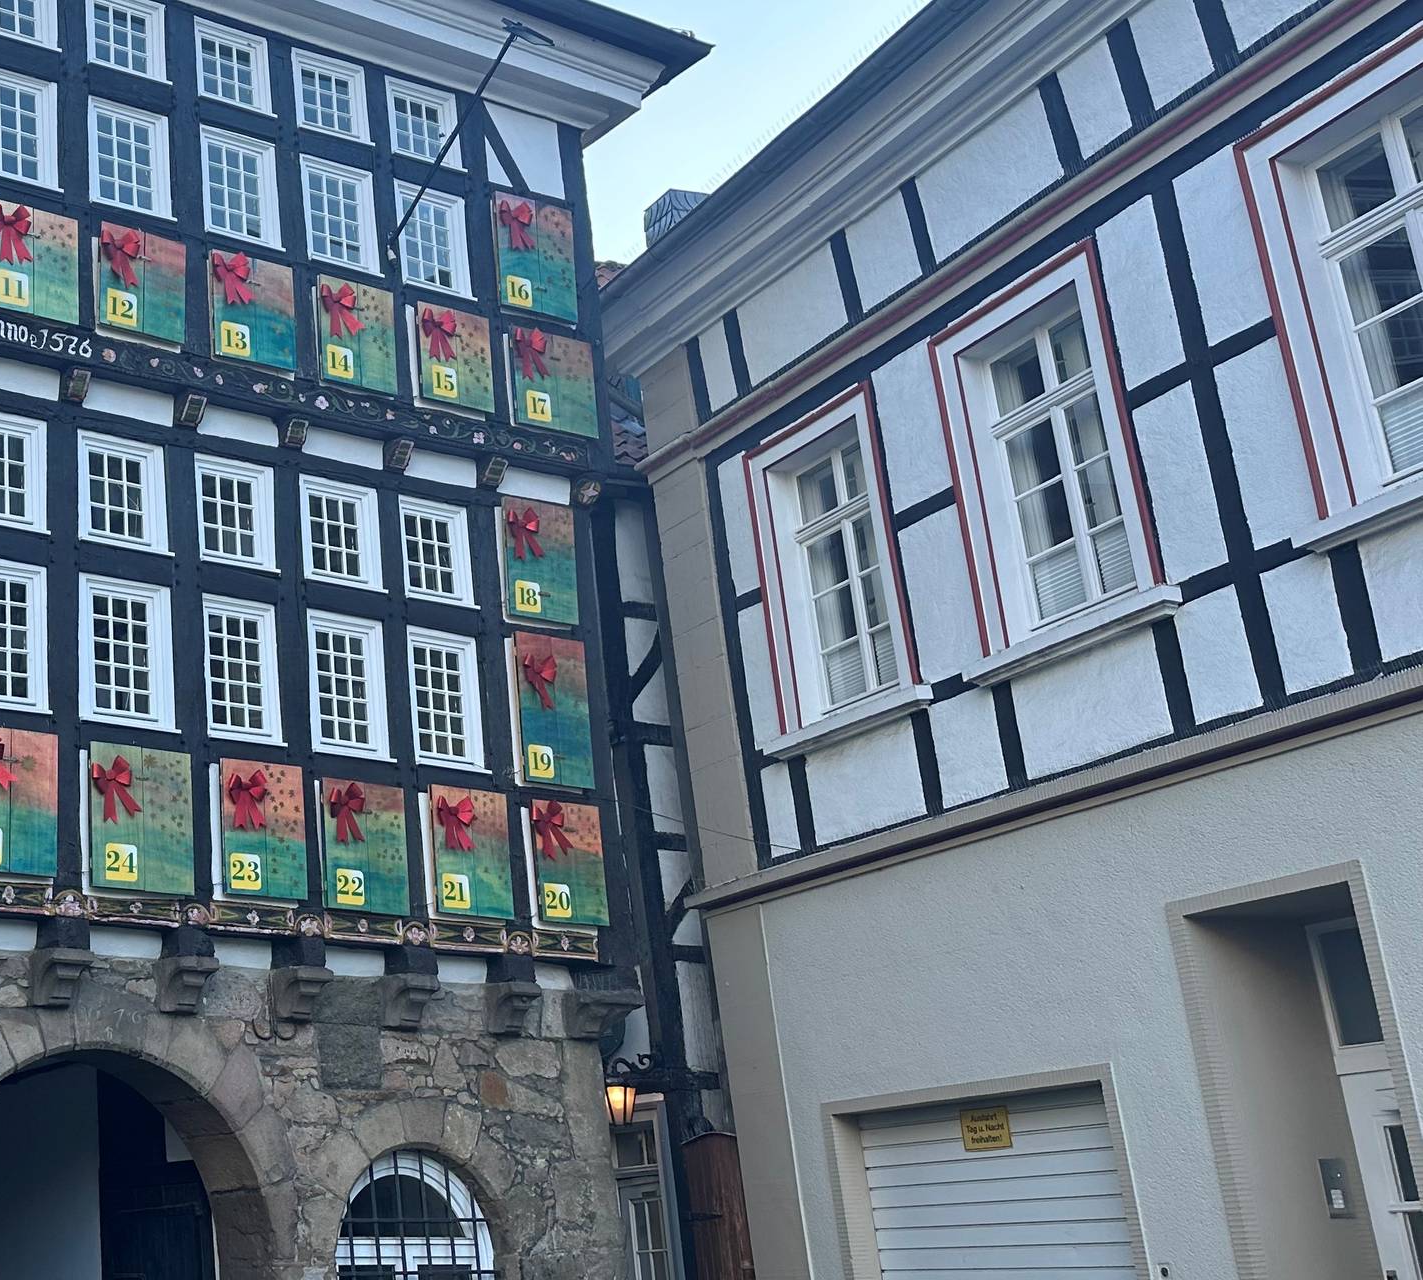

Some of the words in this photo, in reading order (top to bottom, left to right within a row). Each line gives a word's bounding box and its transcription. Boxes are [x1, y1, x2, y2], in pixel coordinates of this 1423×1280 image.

[2, 277, 24, 300] 11
[510, 281, 530, 301] 16
[110, 296, 134, 320] 12
[225, 329, 249, 351] 13
[329, 351, 351, 373] 14
[434, 370, 455, 392] 15
[530, 395, 548, 415] 17
[519, 587, 538, 607] 18
[531, 751, 552, 772] 19
[107, 850, 135, 874] 24
[232, 859, 260, 882] 23
[338, 874, 363, 897] 22
[443, 880, 466, 902] 21
[546, 890, 570, 911] 20
[966, 1125, 978, 1135] Tag
[985, 1122, 1005, 1132] Nacht
